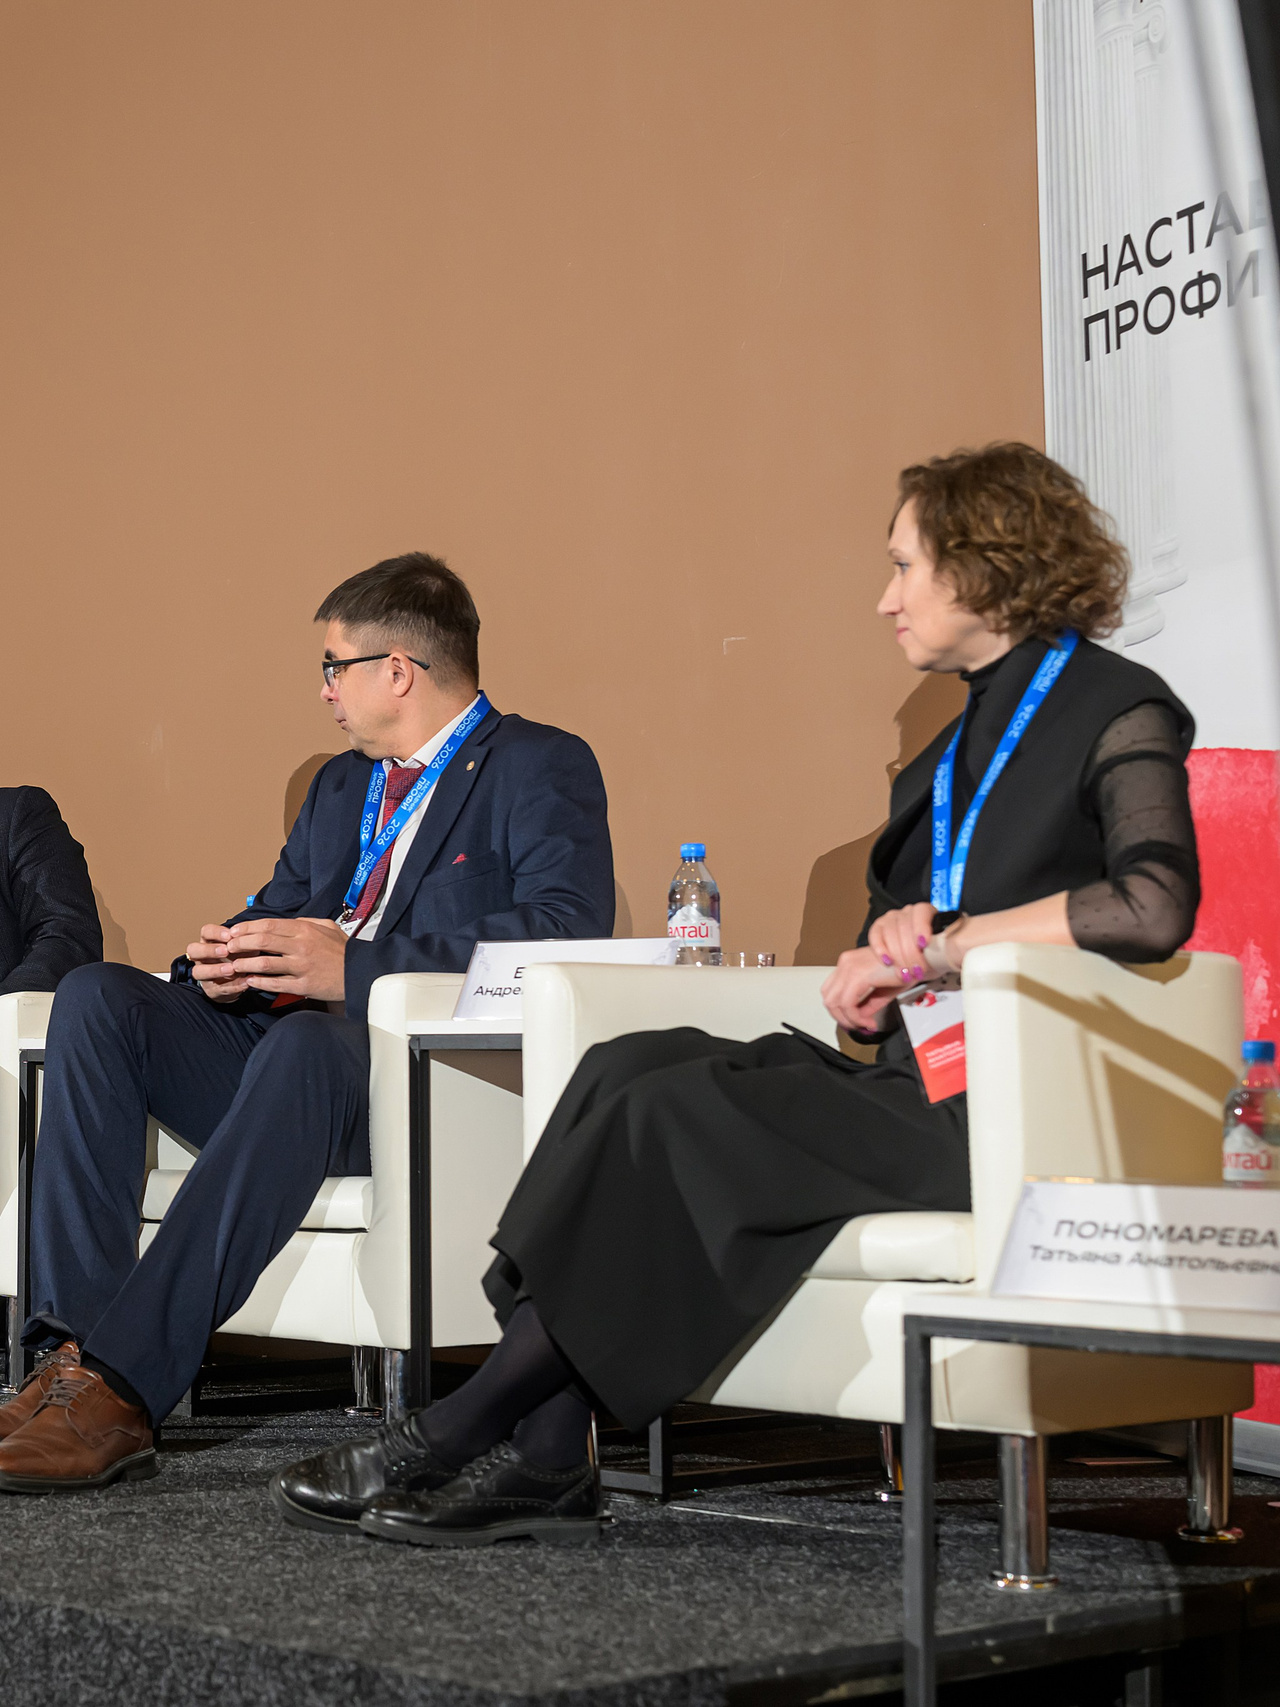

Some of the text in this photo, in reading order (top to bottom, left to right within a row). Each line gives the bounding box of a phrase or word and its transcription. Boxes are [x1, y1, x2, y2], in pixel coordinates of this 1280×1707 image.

[1083, 249, 1262, 363] ПРОФИ
[454, 708, 478, 737] ПРОФИ
[1007, 703, 1035, 738] 2026
[431, 743, 454, 770] 2026
[372, 772, 385, 804] ПРОФИ
[400, 776, 427, 811] ПРОФИ
[361, 812, 374, 840] 2026
[377, 818, 401, 846] 2026
[934, 819, 947, 857] 2026
[353, 851, 374, 886] ПРОФИ
[473, 985, 524, 998] Андре
[1224, 1150, 1273, 1171] лтай
[1054, 1219, 1279, 1250] ПОНОМАРЕВА
[1030, 1244, 1122, 1265] Татьяна
